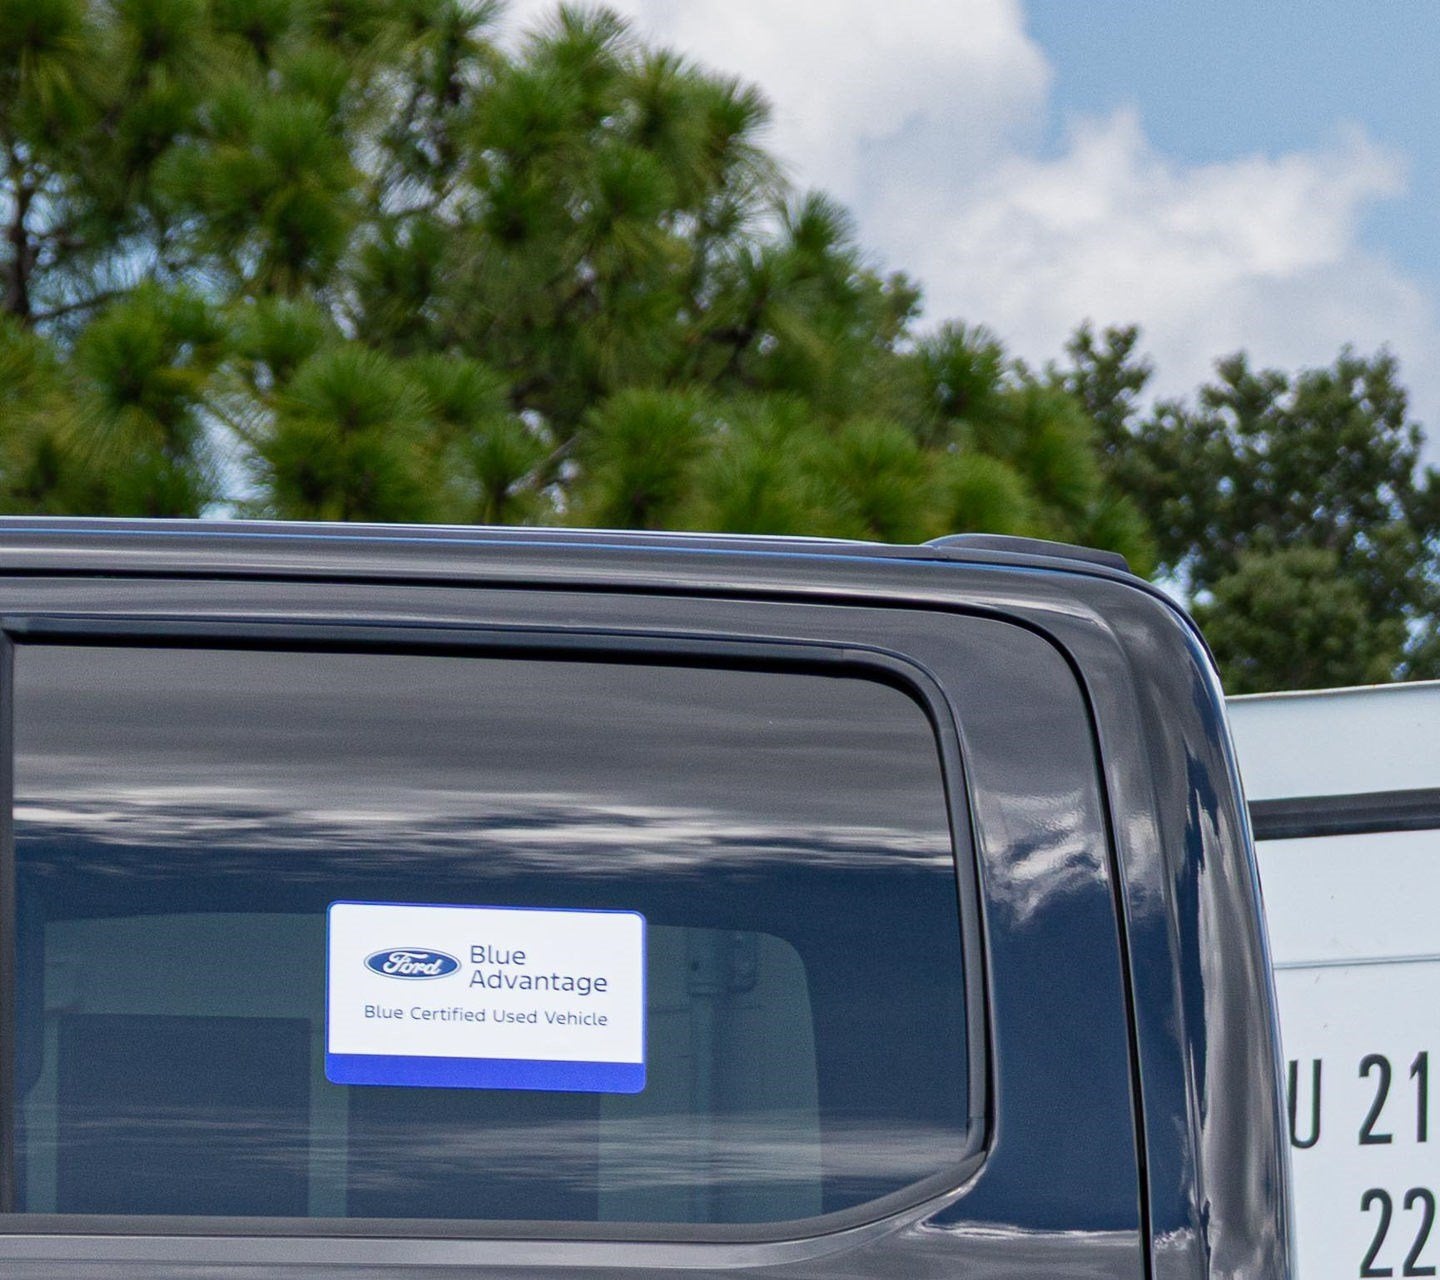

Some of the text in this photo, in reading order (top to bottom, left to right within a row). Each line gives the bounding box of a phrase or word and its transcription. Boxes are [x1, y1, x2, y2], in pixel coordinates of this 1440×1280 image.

[470, 945, 526, 966] Blue
[468, 969, 608, 996] Advantage
[364, 1004, 608, 1026] Blue Certified Used Vehicle
